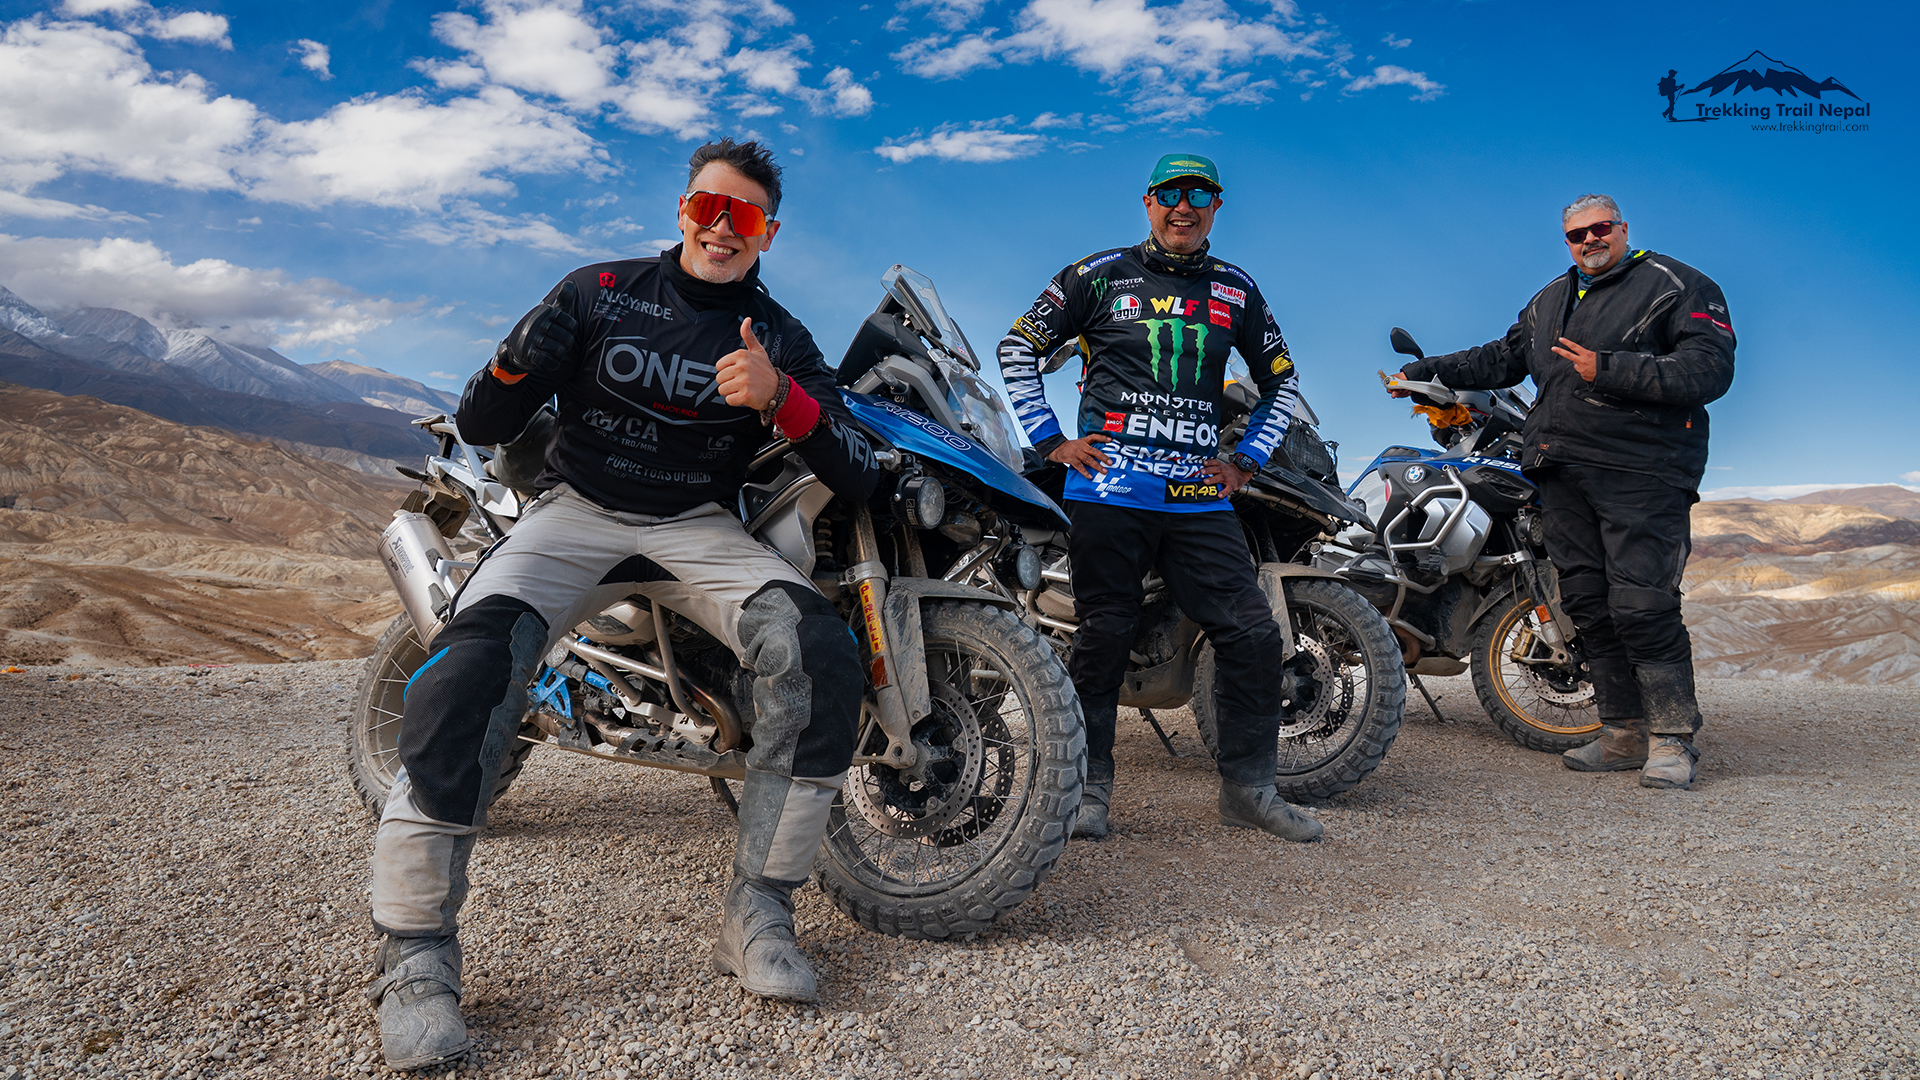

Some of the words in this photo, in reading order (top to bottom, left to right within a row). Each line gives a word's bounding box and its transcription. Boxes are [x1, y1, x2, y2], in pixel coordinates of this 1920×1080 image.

[1089, 252, 1122, 268] MICHELIN
[1150, 295, 1200, 316] WLF
[605, 343, 728, 409] O'NE
[1120, 391, 1213, 413] MONSTER
[1135, 406, 1205, 420] ENERGY
[1126, 413, 1218, 448] ENEOS
[621, 437, 658, 453] TRD/MRK
[605, 453, 672, 481] PURVEYORS
[860, 585, 880, 651] PIRELLI
